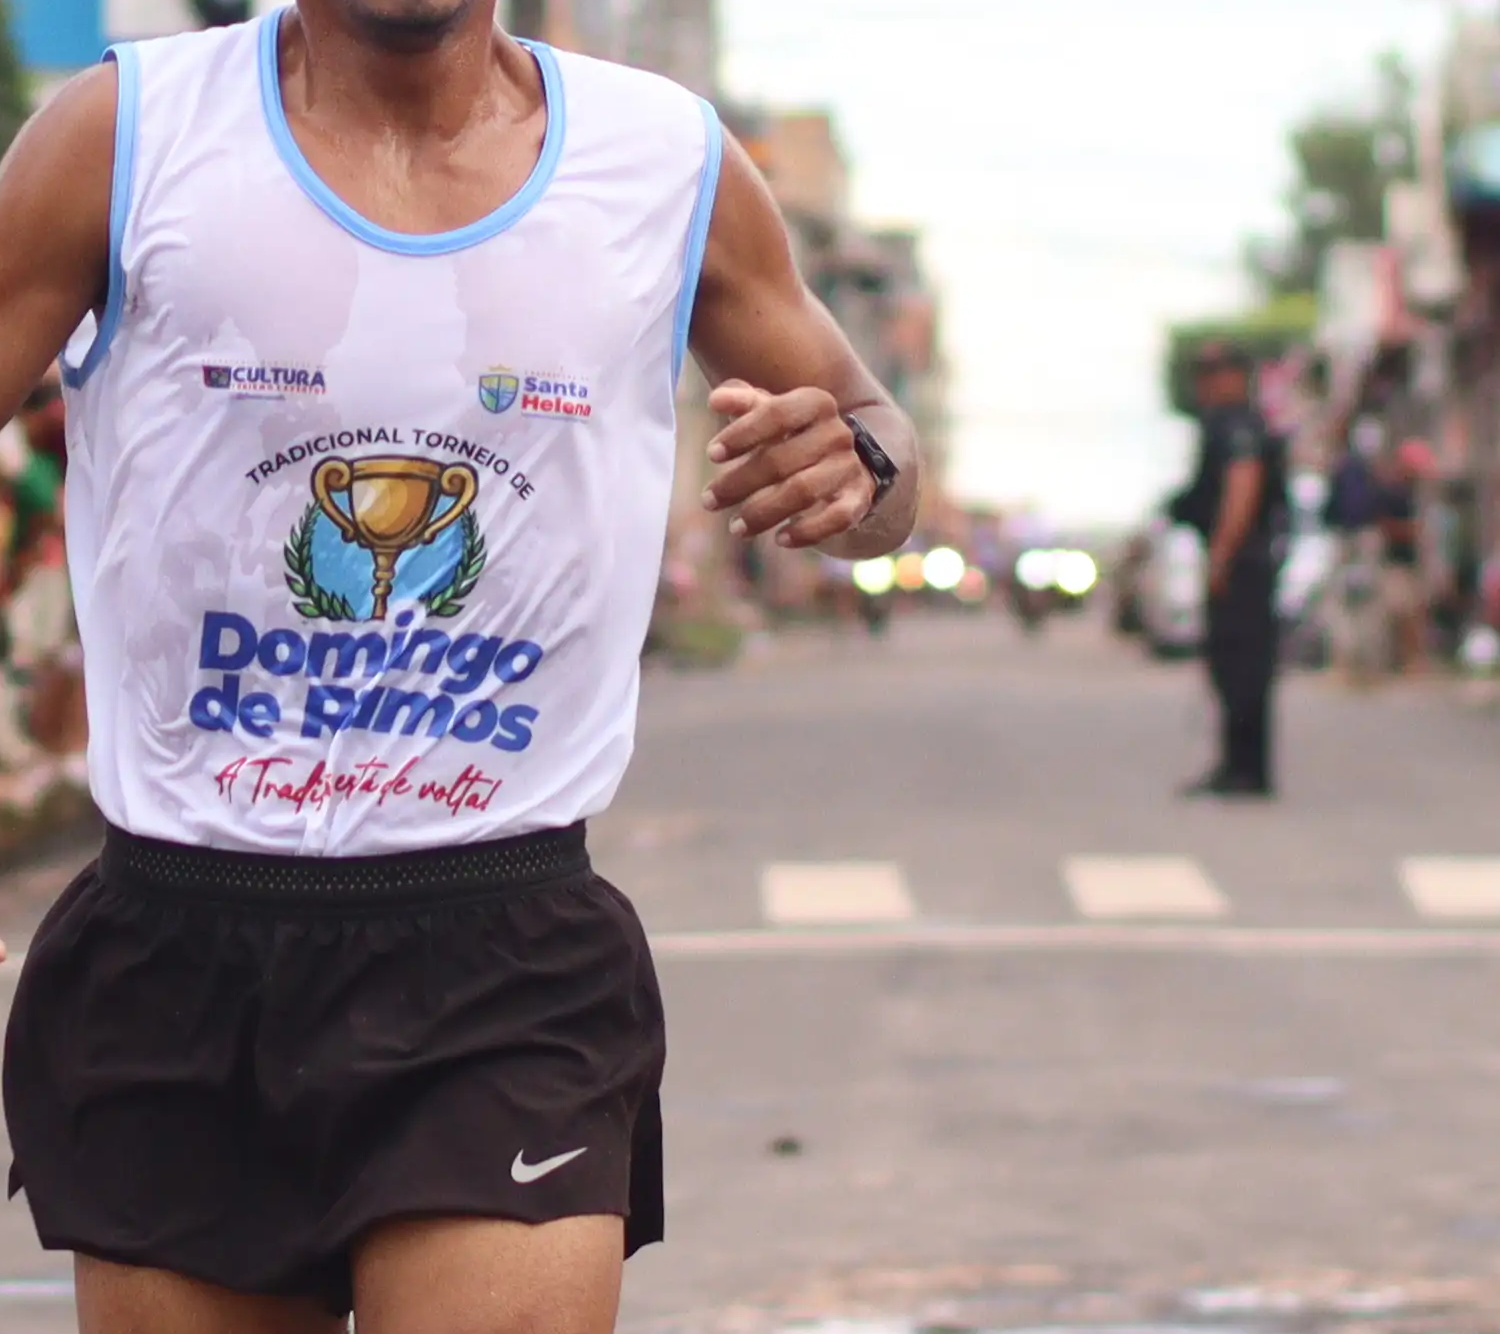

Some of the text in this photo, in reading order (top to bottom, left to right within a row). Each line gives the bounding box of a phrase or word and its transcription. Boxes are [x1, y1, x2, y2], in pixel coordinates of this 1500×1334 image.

[232, 367, 325, 389] CULTURA
[522, 394, 592, 417] Helena
[524, 376, 588, 398] Santa
[245, 427, 536, 501] TRADICIONAL TORNEIO DE
[199, 609, 544, 694] Domingo
[189, 674, 281, 738] de
[214, 755, 247, 803] A
[418, 763, 503, 816] volta!
